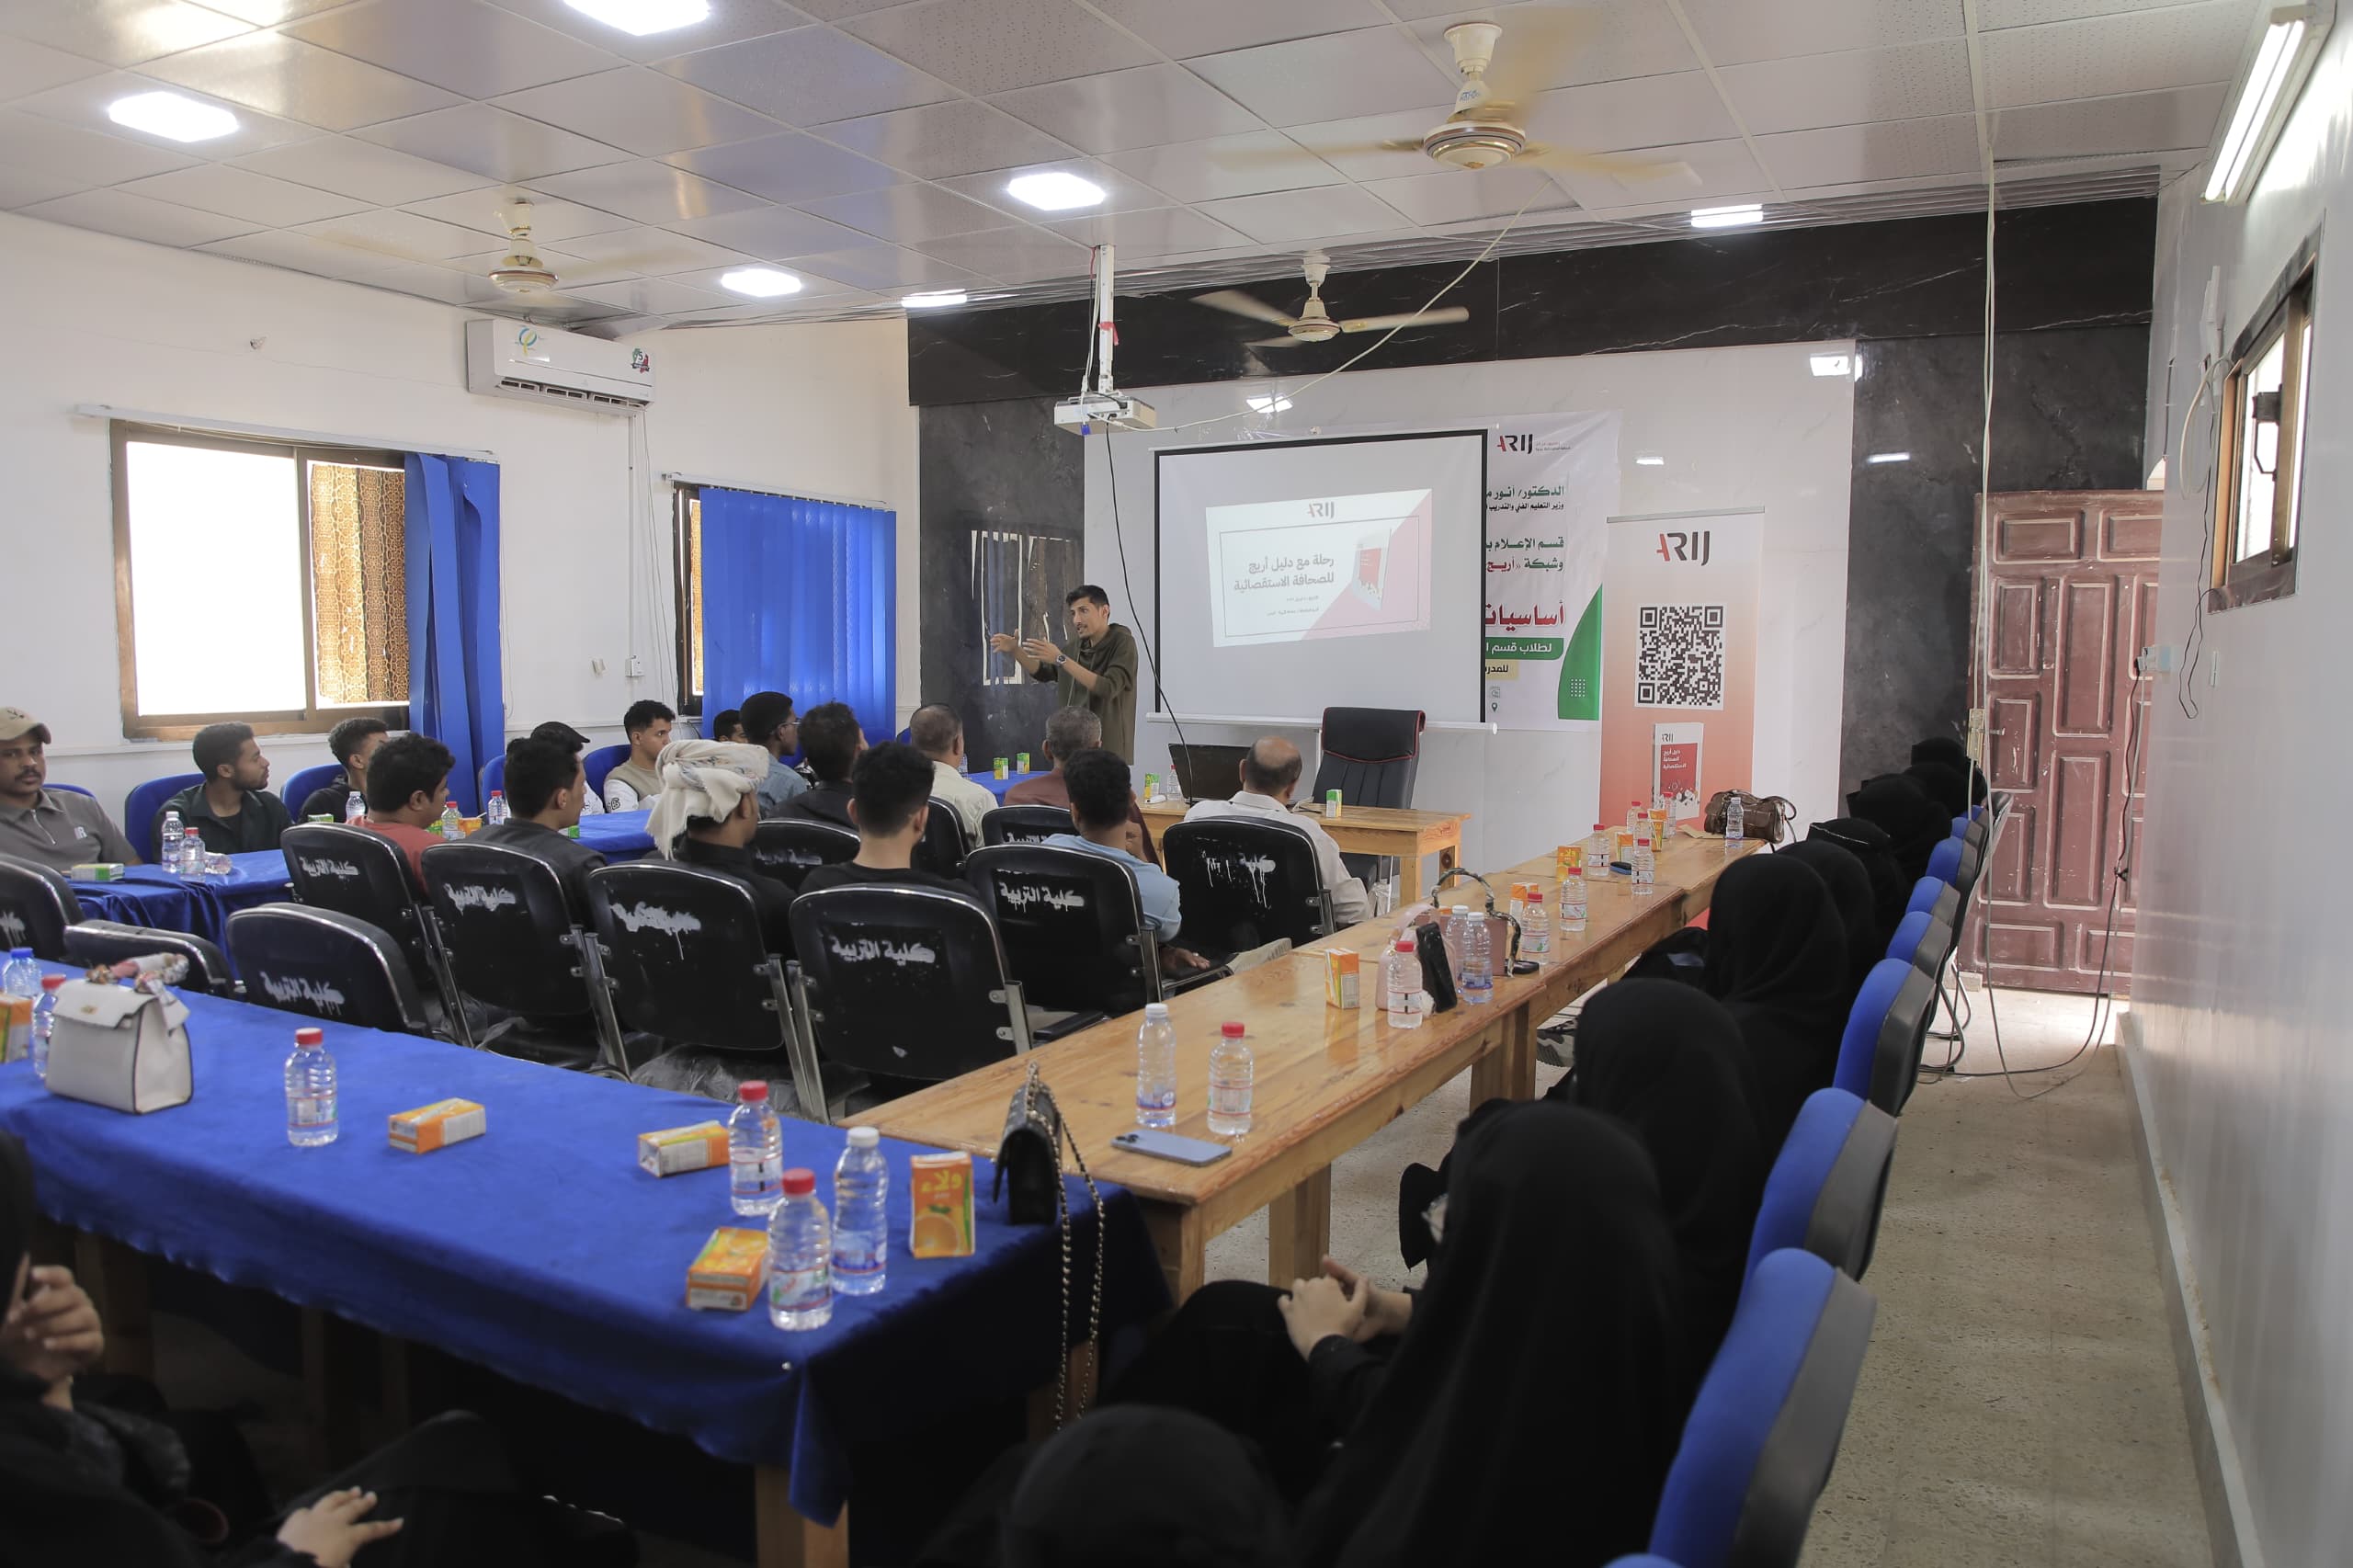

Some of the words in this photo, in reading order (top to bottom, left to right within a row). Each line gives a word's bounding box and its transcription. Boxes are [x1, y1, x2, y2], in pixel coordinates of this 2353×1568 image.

[1497, 434, 1533, 454] ARIJ
[1307, 501, 1335, 518] ARIJ
[1515, 502, 1529, 513] الفني
[1529, 501, 1551, 511] التعليم
[1495, 536, 1535, 551] الإعلام
[1538, 536, 1564, 551] قسم
[1656, 530, 1711, 566] ARIJ
[1248, 555, 1268, 574] أريج
[1271, 556, 1293, 572] دليل
[1296, 558, 1310, 571] مع
[1313, 552, 1335, 568] رحلة
[1524, 556, 1564, 572] وشبكة
[1233, 574, 1290, 594] الاستقصائية
[1292, 571, 1335, 586] للصحافة
[1491, 642, 1518, 655] قسم
[1519, 642, 1552, 655] لطلاب
[1485, 664, 1509, 675] للمدر
[1000, 881, 1040, 907] التربية
[1041, 885, 1086, 910] كلية
[831, 935, 881, 962] التربية
[884, 938, 936, 966] كلية
